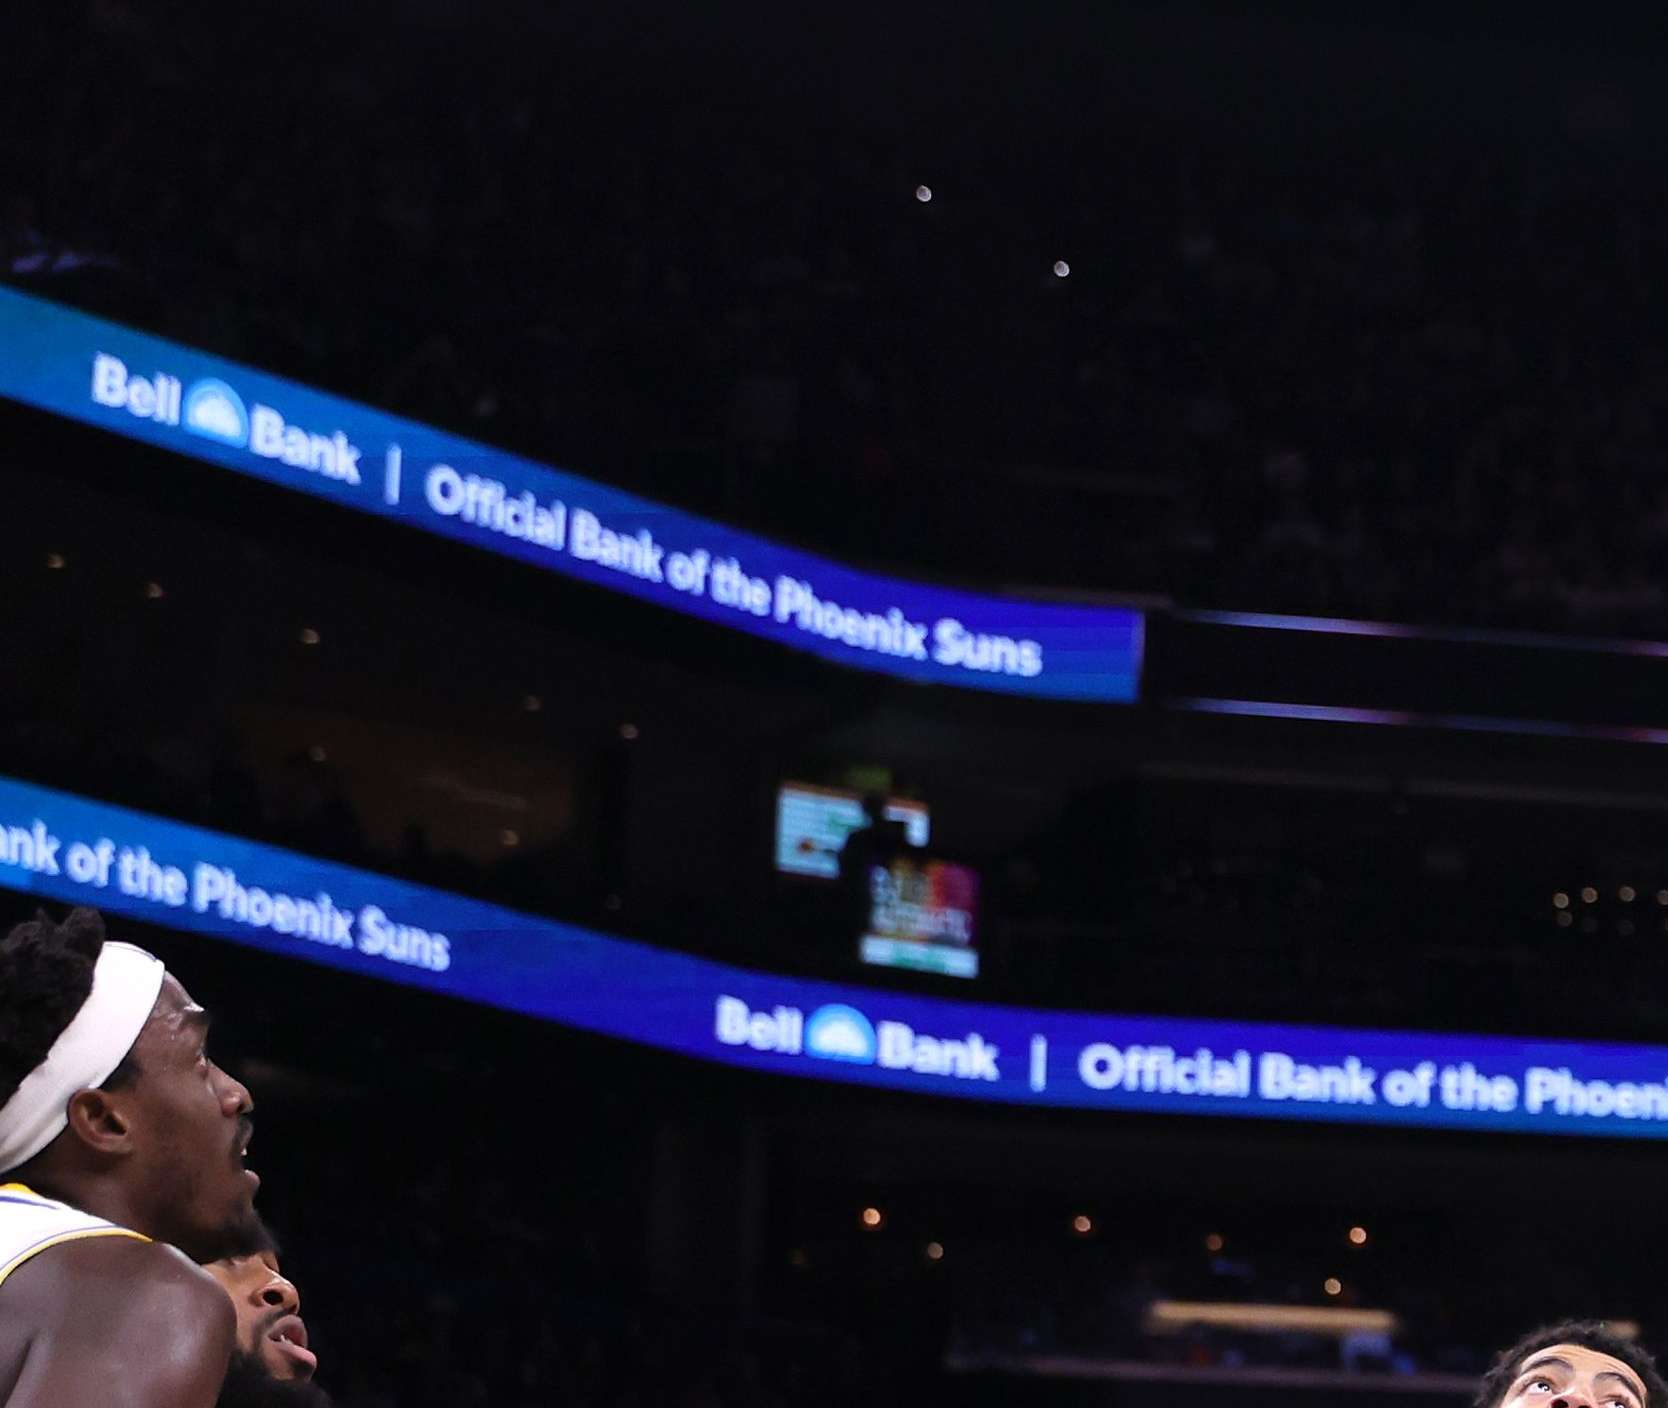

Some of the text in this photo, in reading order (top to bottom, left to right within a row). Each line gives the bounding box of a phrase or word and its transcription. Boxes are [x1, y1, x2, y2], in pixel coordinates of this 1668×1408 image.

[93, 354, 1042, 676] Bell Bank Official Bank of the Phoenix Suns
[67, 839, 115, 886] of
[118, 848, 188, 905] the
[198, 863, 354, 947] Phoenix
[360, 906, 449, 971] Suns
[716, 996, 802, 1054] Bell
[877, 1021, 998, 1080] Bank
[1079, 1043, 1250, 1097] Official
[1259, 1053, 1375, 1104] Bank
[1382, 1062, 1436, 1106] of
[1439, 1064, 1518, 1111] the
